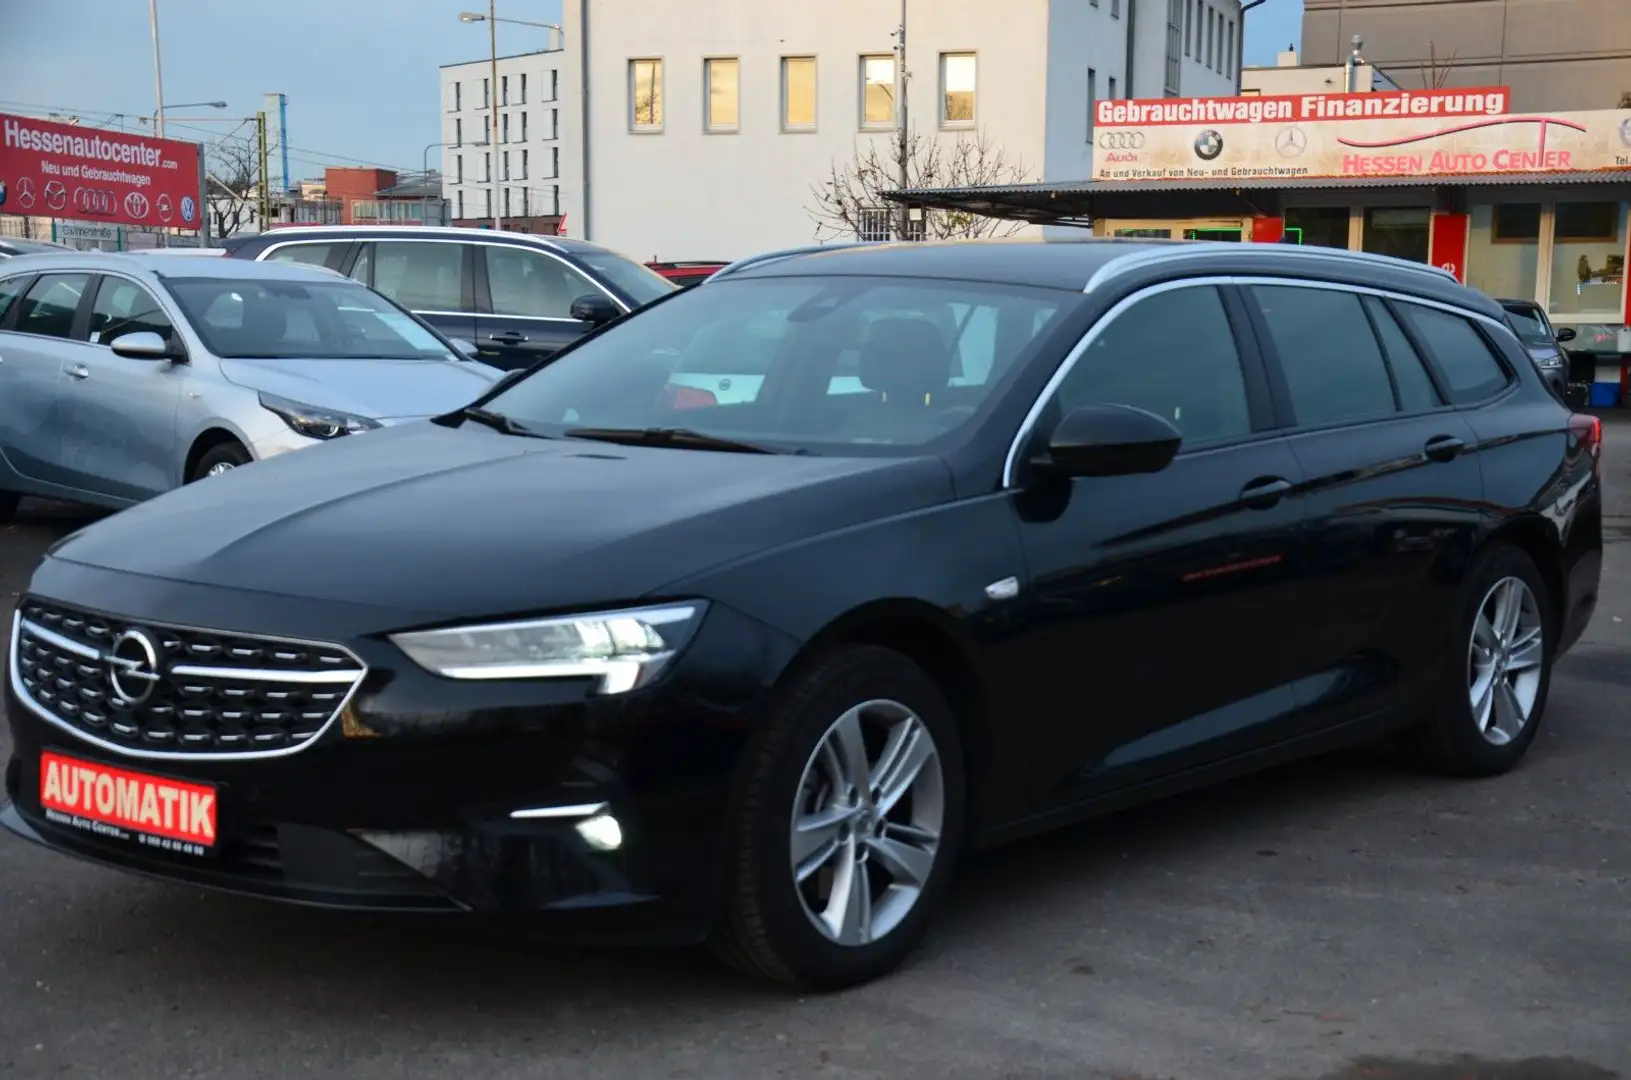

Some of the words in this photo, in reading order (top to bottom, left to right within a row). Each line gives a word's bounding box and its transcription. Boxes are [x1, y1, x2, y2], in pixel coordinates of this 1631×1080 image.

[1098, 99, 1292, 122] Gebrauchtwagen
[1301, 93, 1504, 115] Finanzierung
[4, 119, 178, 169] Hessenautocenter.com
[41, 160, 60, 174] Neu
[62, 164, 79, 177] und
[81, 164, 151, 187] Gebrauchtwagen
[1099, 168, 1111, 178] An
[1113, 168, 1129, 178] und
[1132, 167, 1166, 178] Verkauf
[1168, 168, 1184, 177] von
[1187, 166, 1209, 177] Neu-
[1211, 166, 1228, 177] und
[1231, 164, 1308, 178] Gebrauchtwagen
[1343, 154, 1422, 173] HESSEN
[1429, 152, 1487, 171] AUTO
[44, 760, 214, 837] AUTOMATIK
